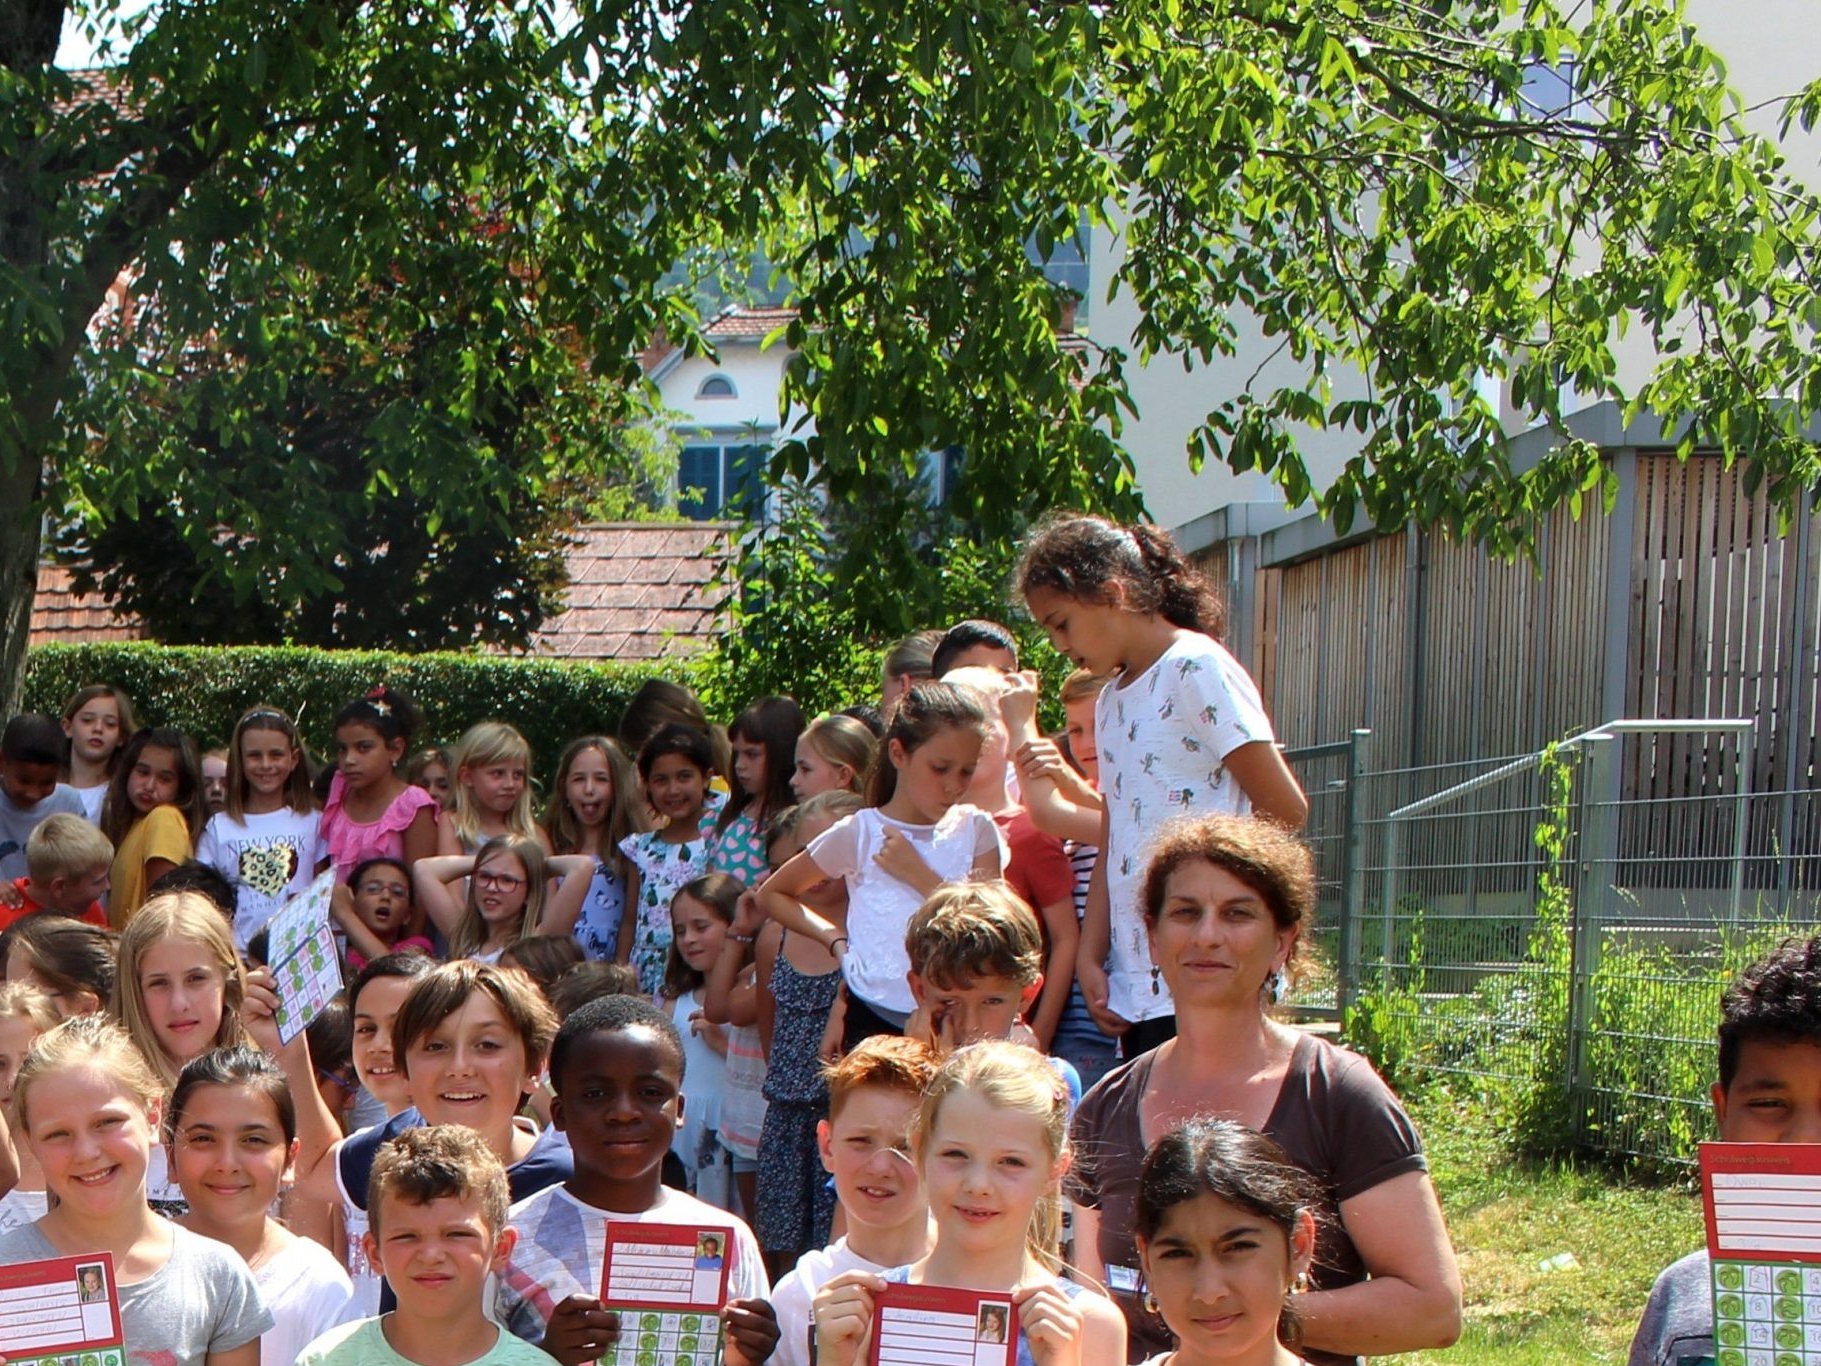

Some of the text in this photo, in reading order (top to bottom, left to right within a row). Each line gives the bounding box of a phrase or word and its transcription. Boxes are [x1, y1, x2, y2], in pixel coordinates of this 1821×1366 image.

[228, 834, 305, 858] NEW YORK
[1754, 1275, 1819, 1285] 2 4
[1755, 1303, 1762, 1312] 8
[1755, 1357, 1767, 1366] 20
